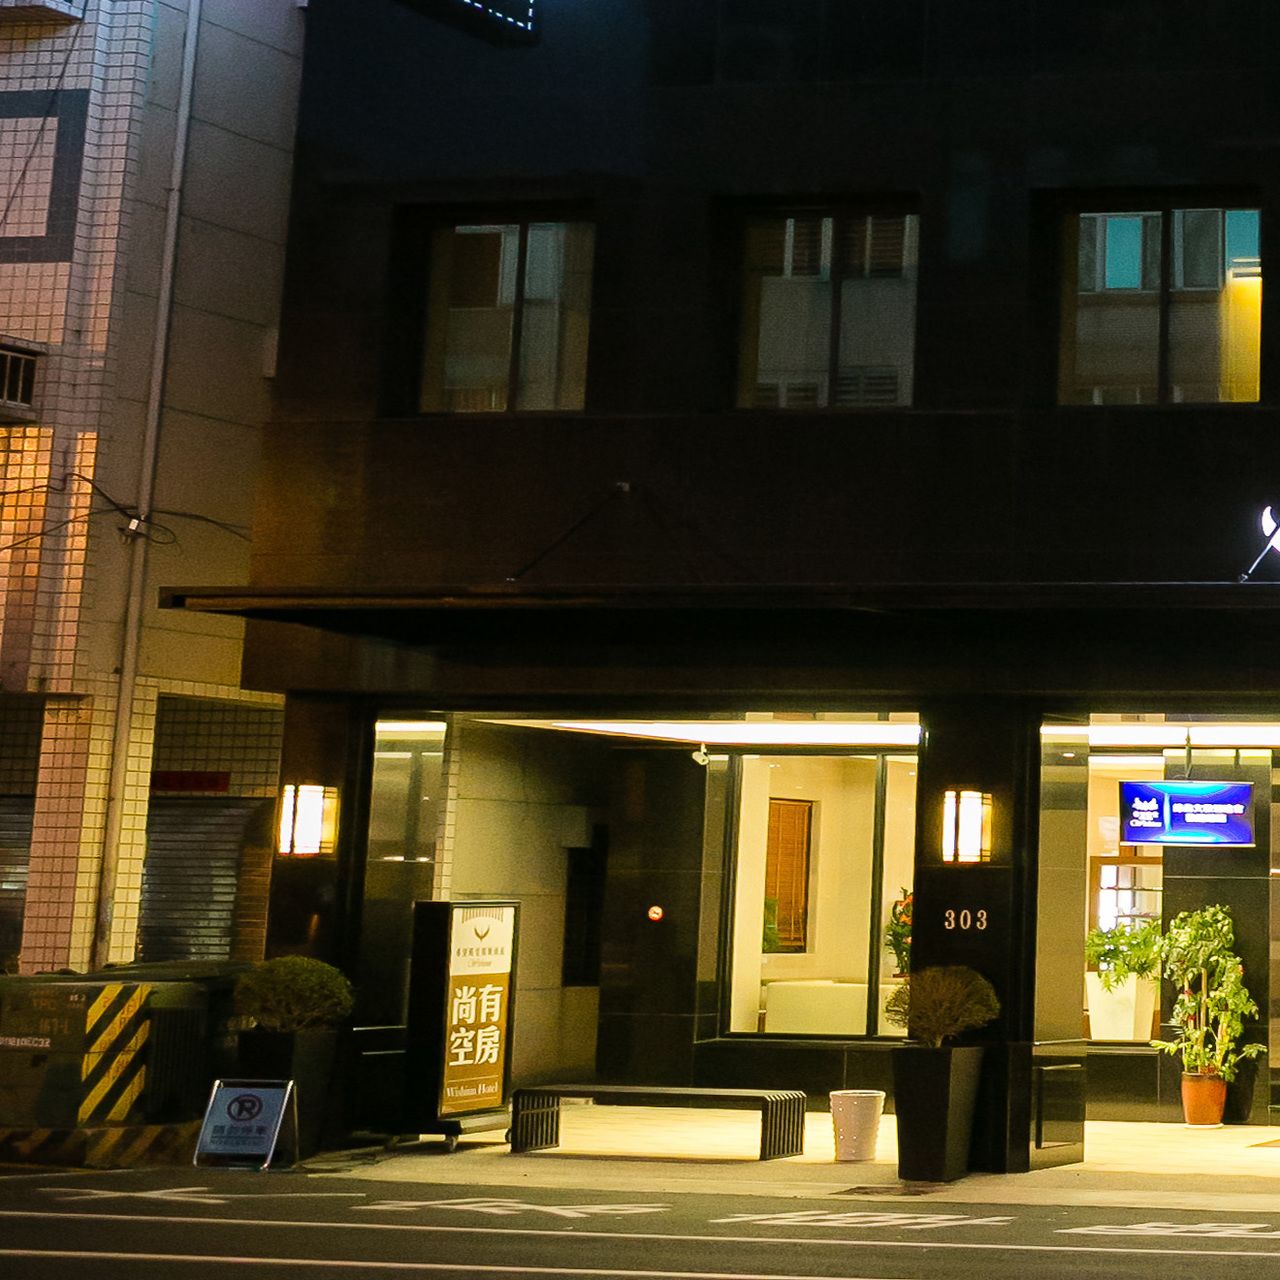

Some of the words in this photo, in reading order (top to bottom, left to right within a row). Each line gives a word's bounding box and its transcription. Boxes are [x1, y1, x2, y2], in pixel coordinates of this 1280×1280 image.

[944, 909, 988, 930] 303
[452, 984, 504, 1025] 尚有
[449, 1025, 500, 1066] 空房
